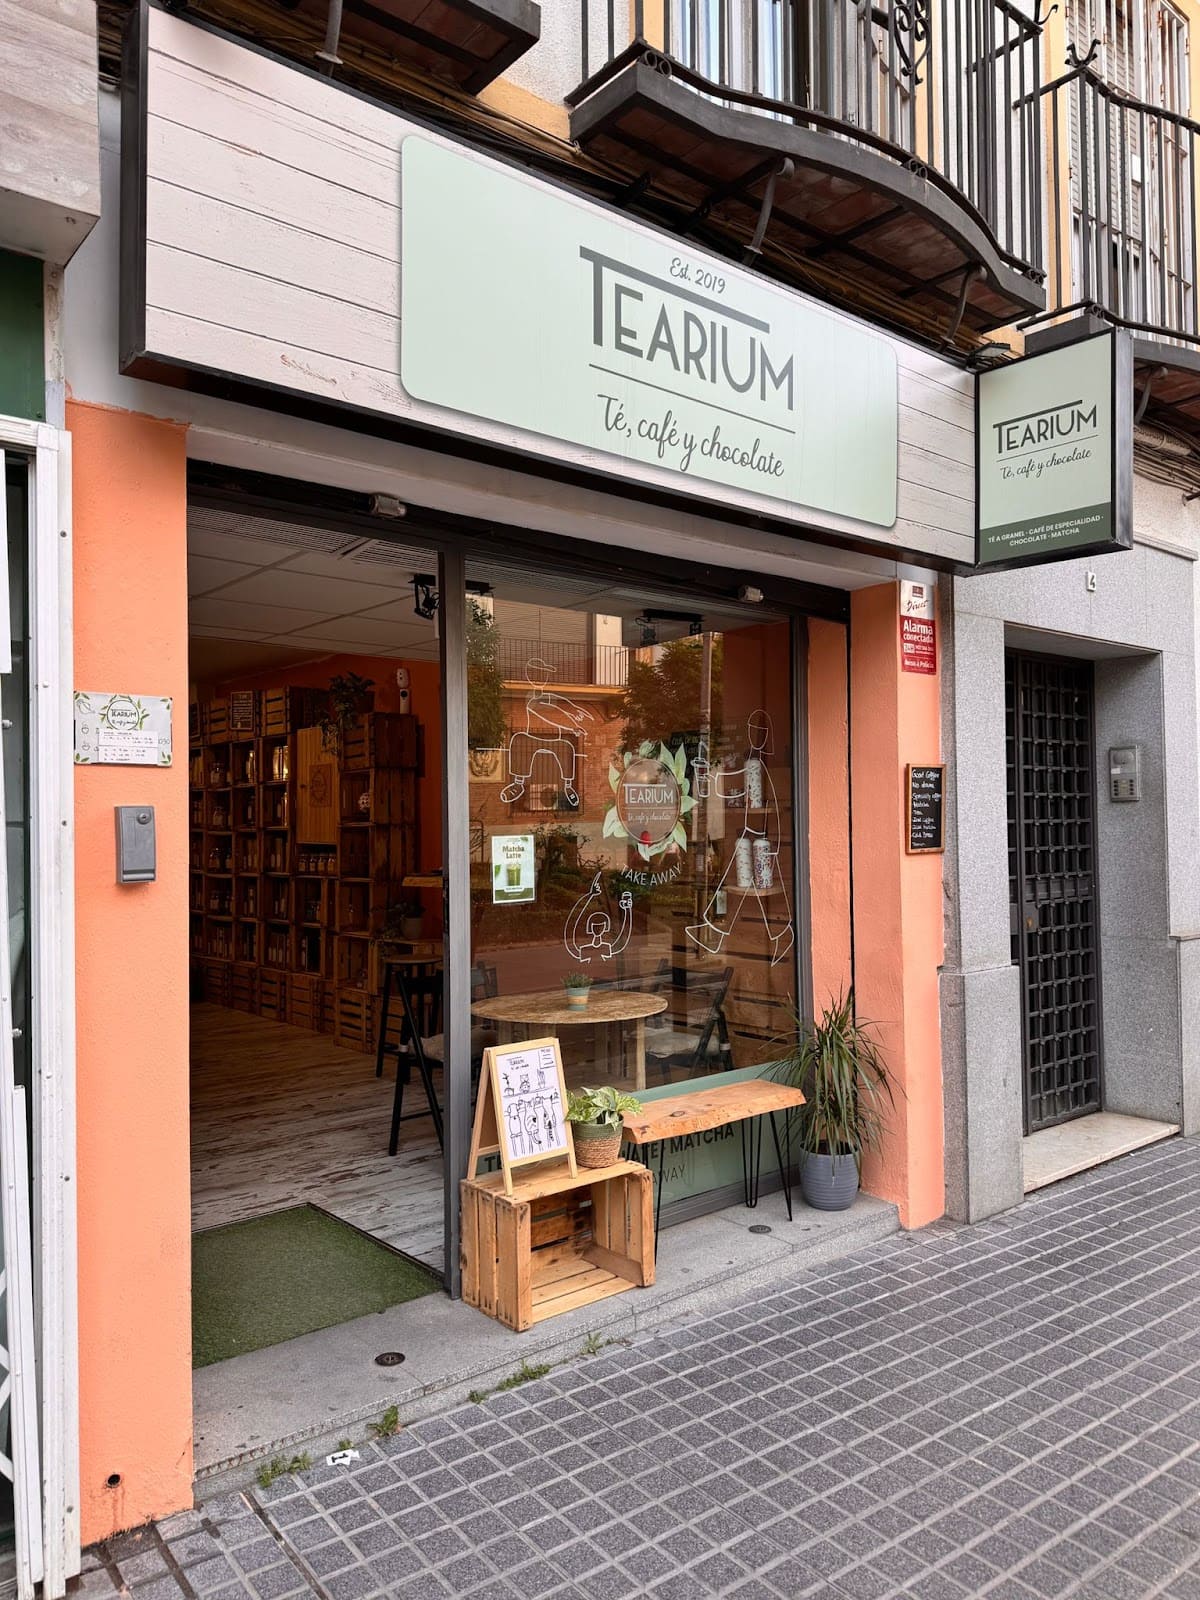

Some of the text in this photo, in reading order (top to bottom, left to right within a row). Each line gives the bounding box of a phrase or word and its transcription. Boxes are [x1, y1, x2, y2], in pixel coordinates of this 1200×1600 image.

[670, 257, 726, 294] Est. 2019
[579, 245, 794, 411] TEARIUM
[597, 394, 784, 477] Té, café y chocolate
[993, 399, 1097, 454] TEARIUM
[1017, 459, 1036, 478] café
[1037, 462, 1044, 478] y
[1046, 447, 1091, 468] chocolate
[1001, 531, 1025, 540] GRANEL
[1029, 526, 1045, 535] CAFÉ
[1046, 524, 1054, 532] DE
[1054, 514, 1101, 530] ESPECIALIDAD
[1009, 527, 1080, 546] CHOCOLATE MATCHA
[903, 619, 933, 635] Alarma
[903, 633, 933, 643] conectada
[623, 783, 674, 804] TEARIUM
[502, 845, 525, 853] Matcha
[620, 863, 682, 886] TAKE AWAY
